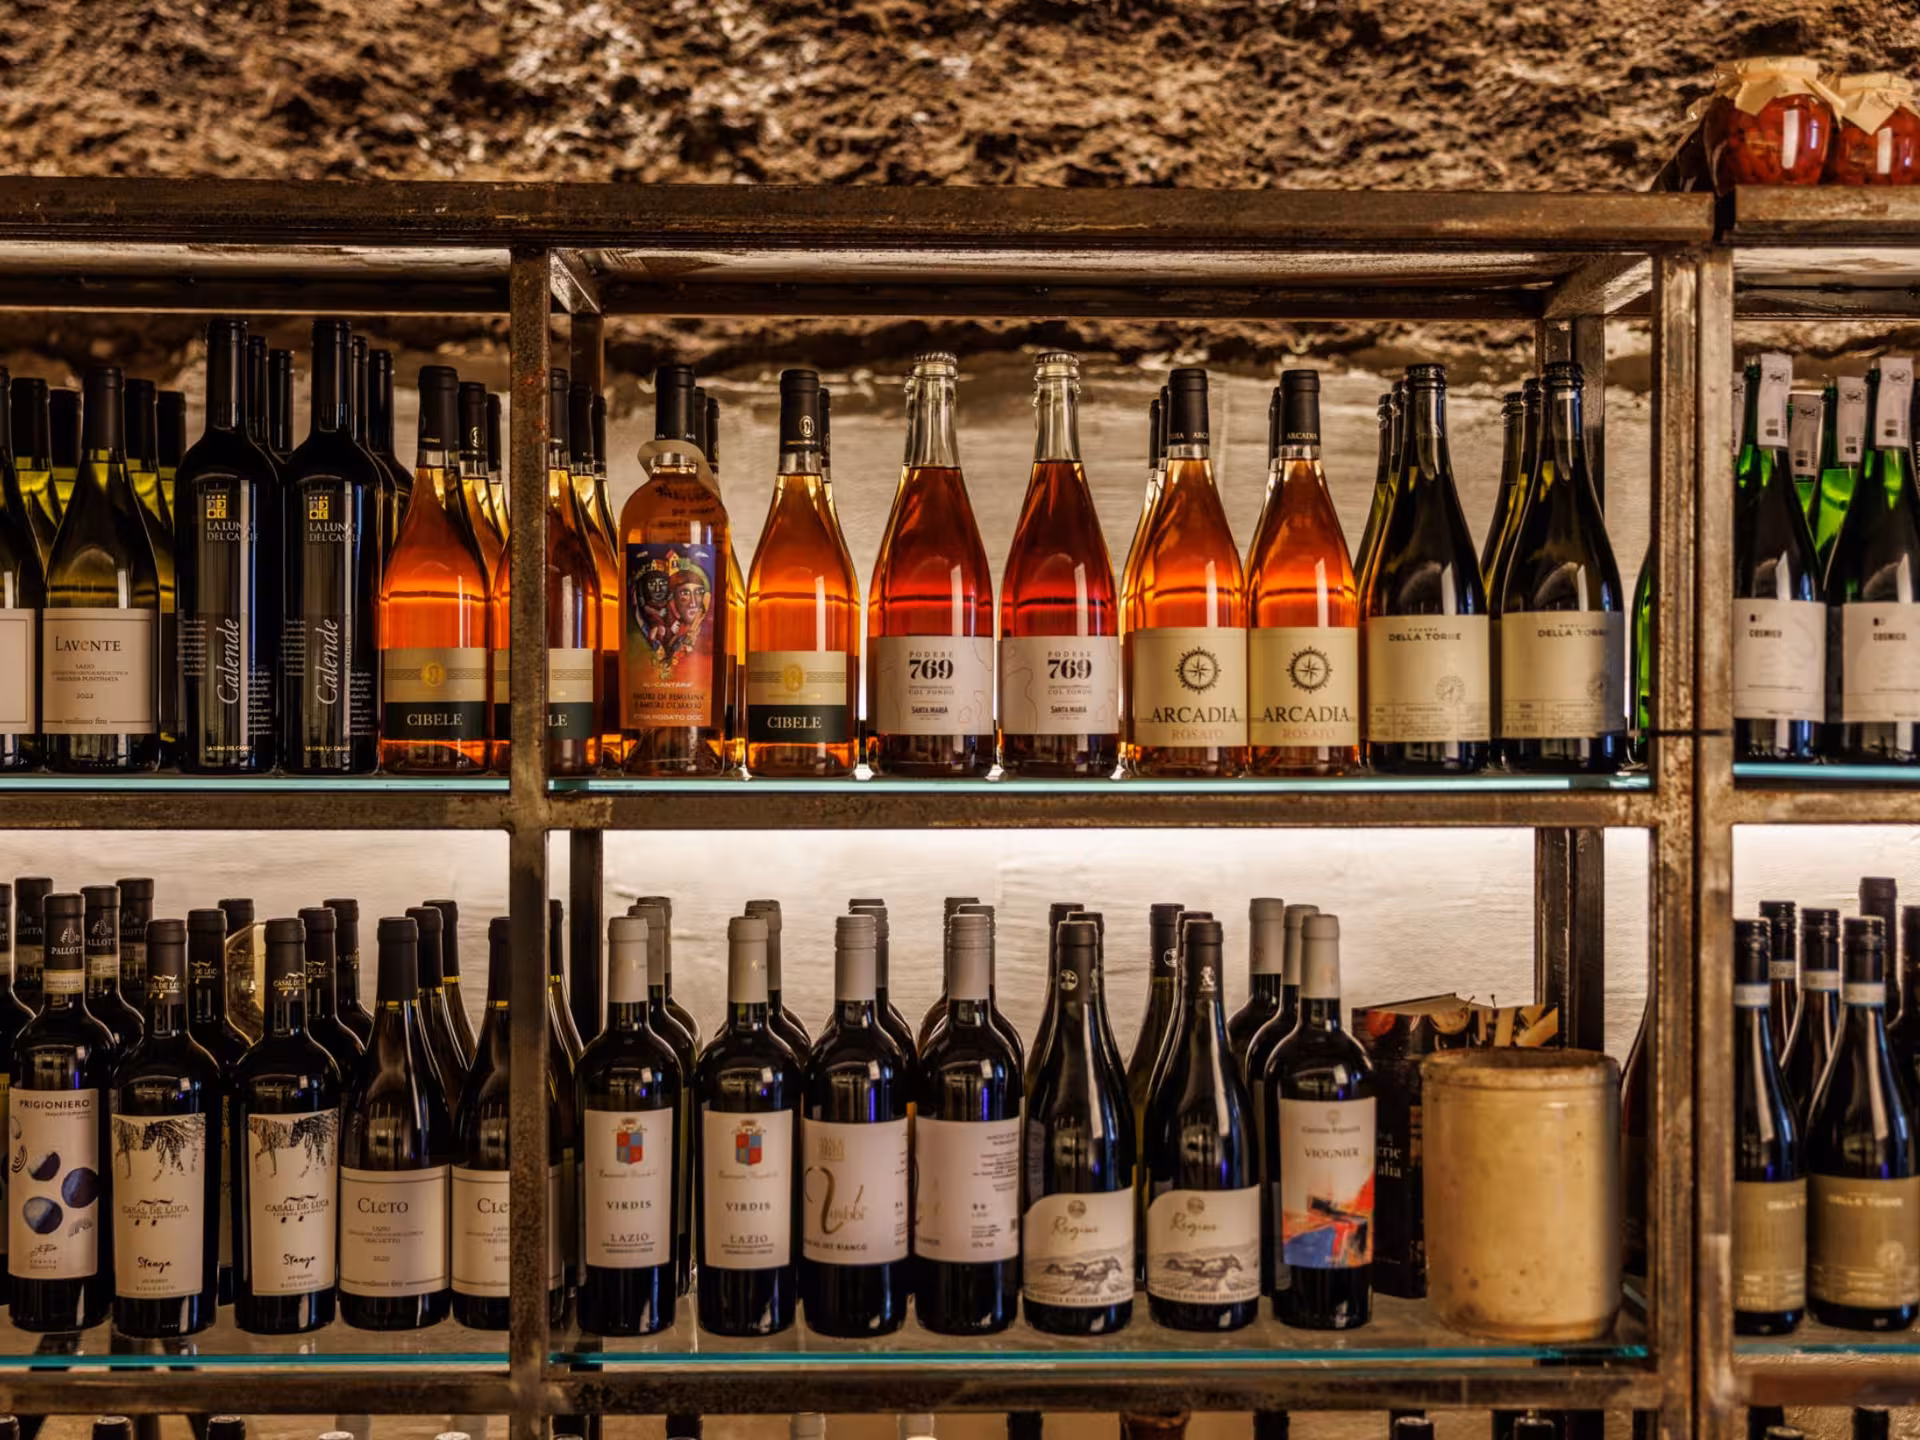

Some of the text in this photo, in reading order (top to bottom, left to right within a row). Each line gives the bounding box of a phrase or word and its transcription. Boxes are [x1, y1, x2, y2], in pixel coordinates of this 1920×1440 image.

[1389, 633, 1421, 641] DELLA
[1537, 629, 1572, 637] DELLA
[216, 618, 240, 704] Calende
[315, 619, 338, 704] Calende
[909, 659, 954, 679] 769
[1047, 659, 1092, 679] 769
[407, 713, 463, 726] CIBELE
[1152, 707, 1238, 723] ARCADIA
[1263, 706, 1350, 723] ARCADIA
[767, 716, 822, 729] CIBELE
[20, 1099, 89, 1110] PRIGIONIERO
[1304, 1147, 1359, 1158] VIOGNIER
[606, 1200, 651, 1210] VIRDIS
[725, 1201, 771, 1211] VIRDIS
[611, 1232, 649, 1243] LAZIO
[730, 1234, 769, 1244] LAZIO
